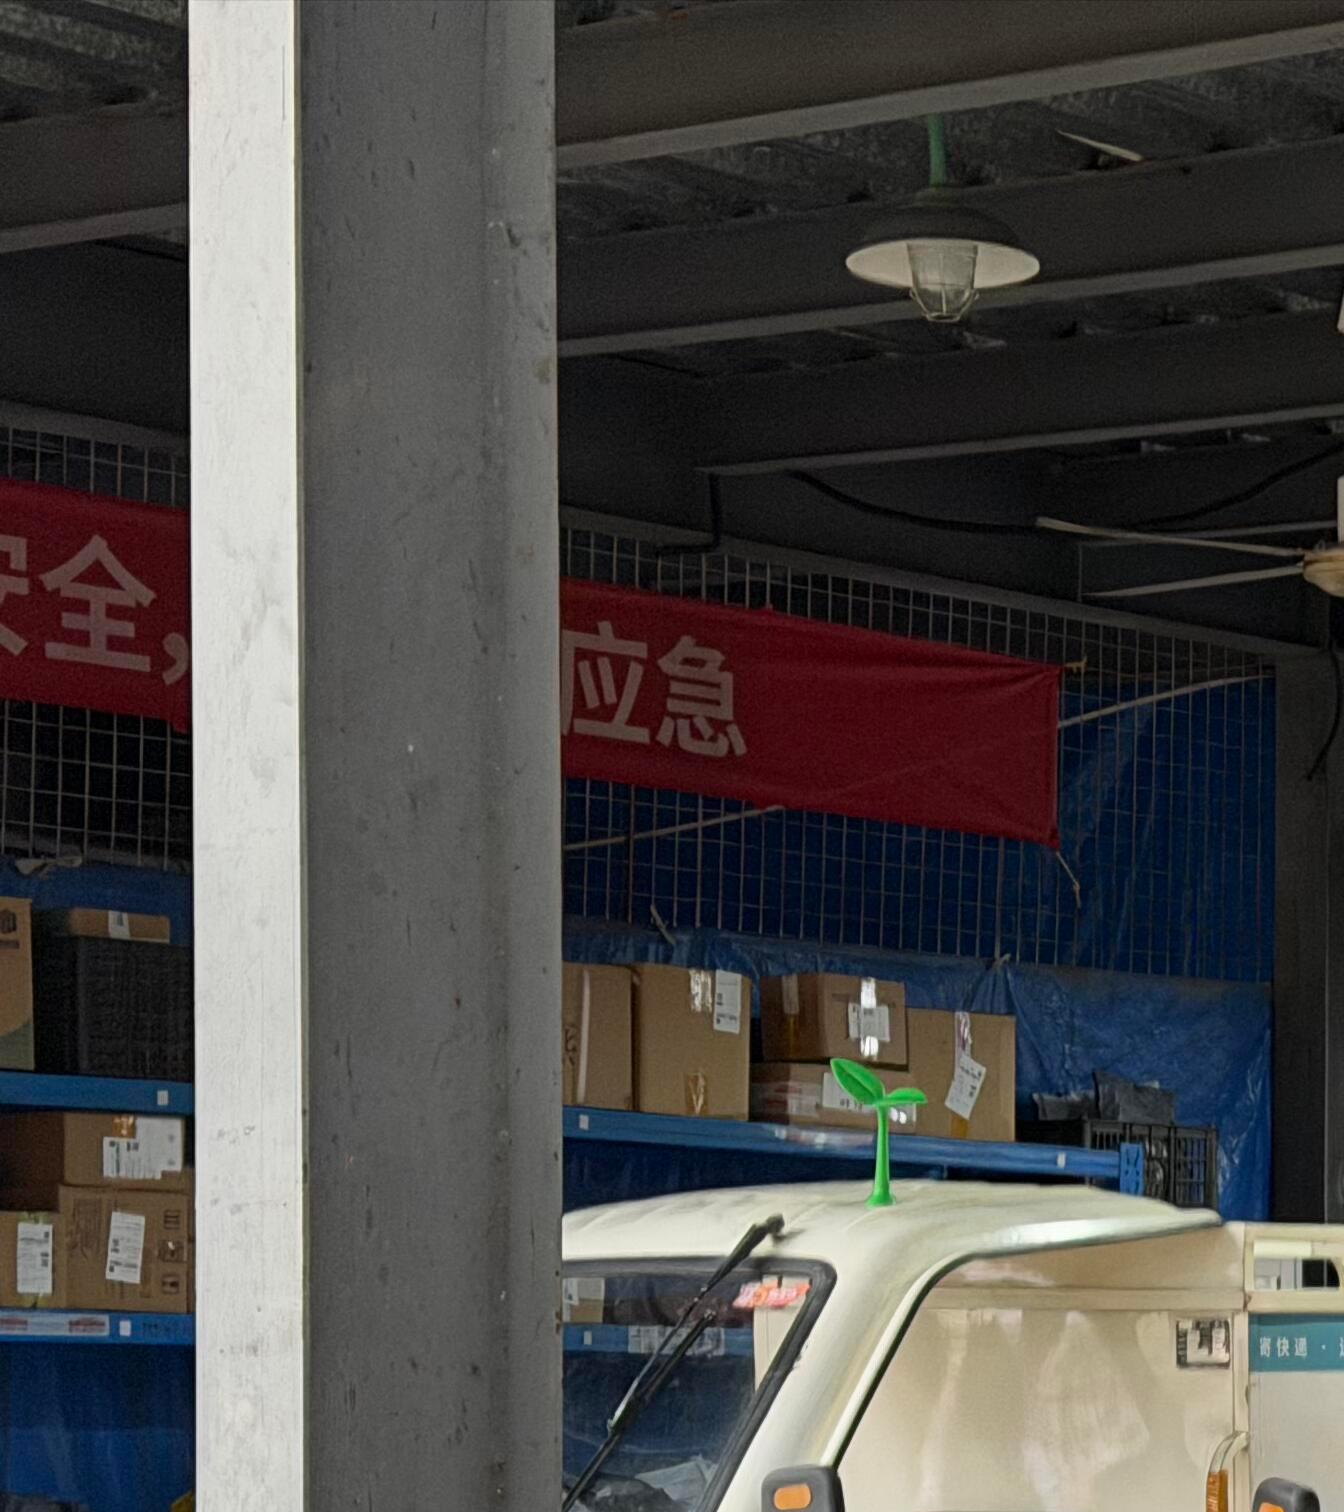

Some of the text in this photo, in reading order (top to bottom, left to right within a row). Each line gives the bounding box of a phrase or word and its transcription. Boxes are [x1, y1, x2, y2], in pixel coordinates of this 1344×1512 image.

[0, 534, 747, 758] 全， 应急
[1259, 1336, 1308, 1357] 寄快递
